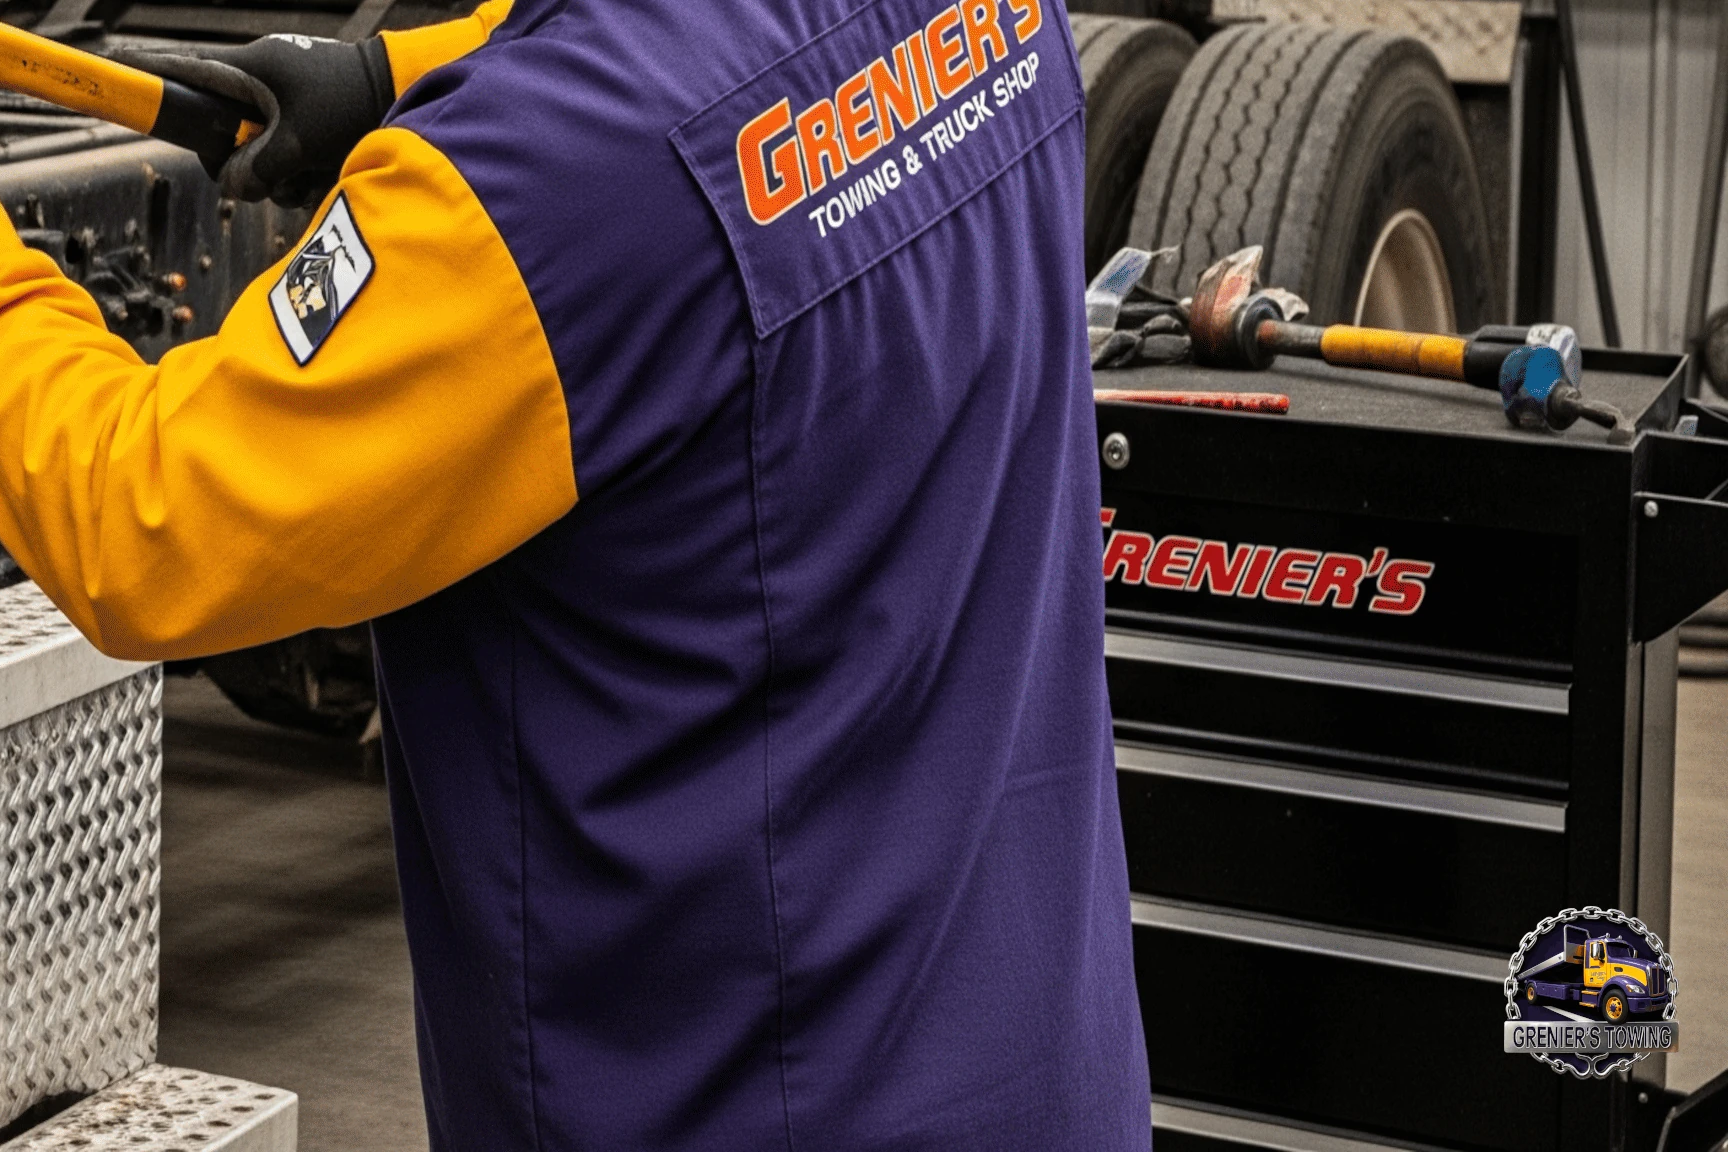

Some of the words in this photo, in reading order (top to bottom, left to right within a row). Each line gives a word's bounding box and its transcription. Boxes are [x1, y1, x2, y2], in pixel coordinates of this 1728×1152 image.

[808, 159, 901, 237] TOWING
[901, 144, 923, 175] &
[919, 90, 995, 161] TRUCK
[992, 51, 1040, 108] SHOP
[1100, 507, 1435, 615] RENIER'S
